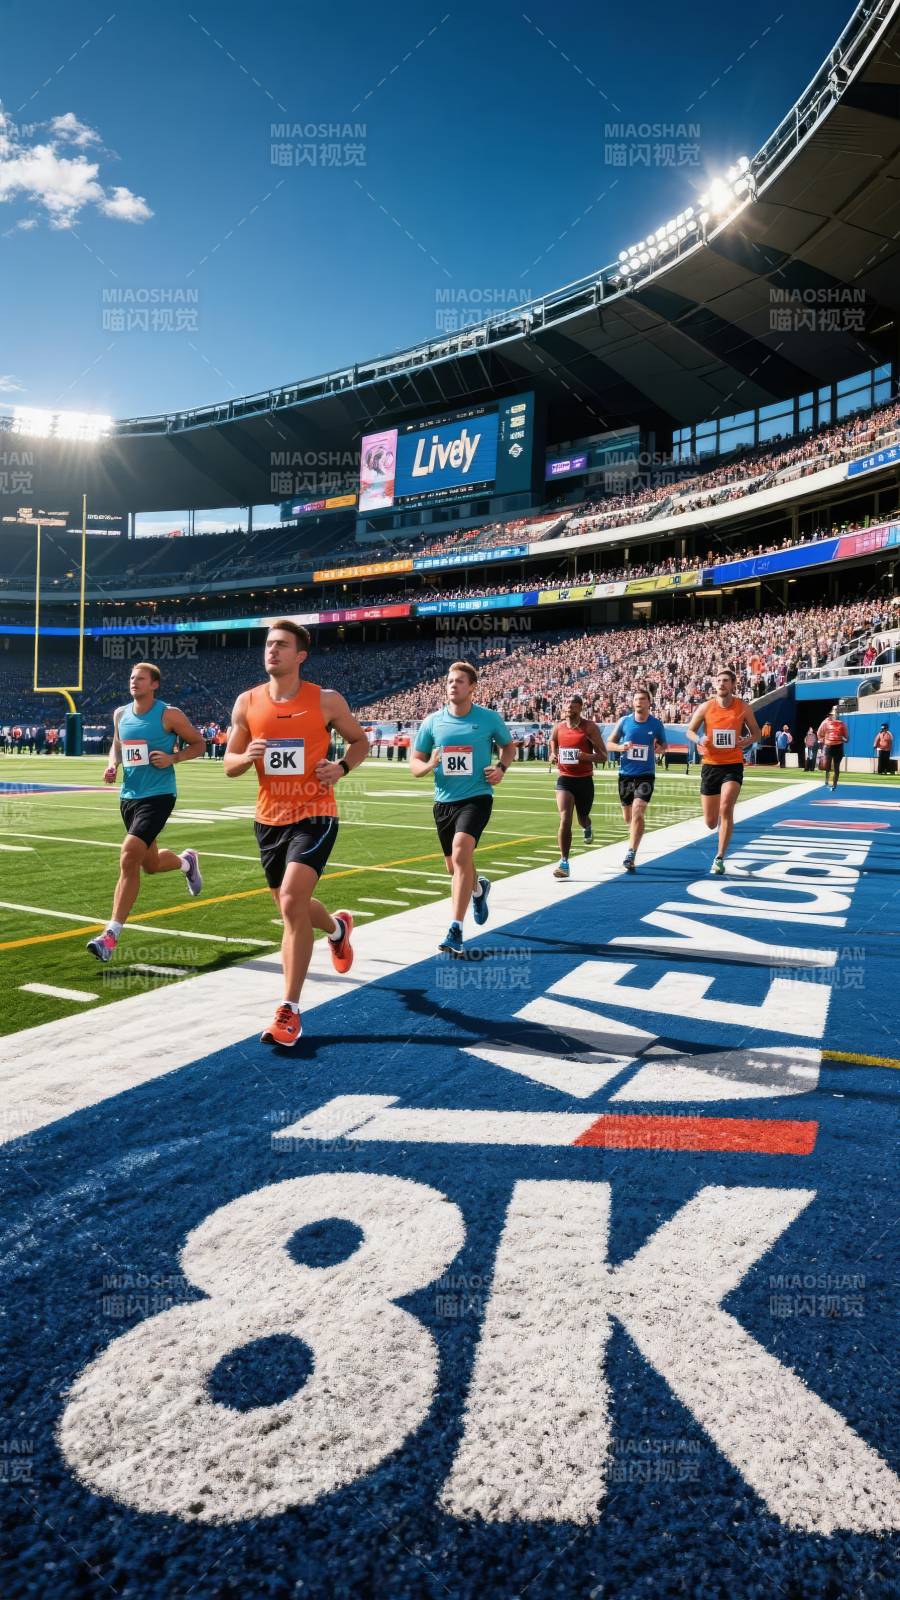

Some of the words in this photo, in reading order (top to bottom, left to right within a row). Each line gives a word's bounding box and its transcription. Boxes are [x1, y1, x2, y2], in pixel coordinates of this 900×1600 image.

[270, 751, 297, 768] 8K
[447, 756, 469, 770] 8K
[57, 1172, 900, 1535] 8K
